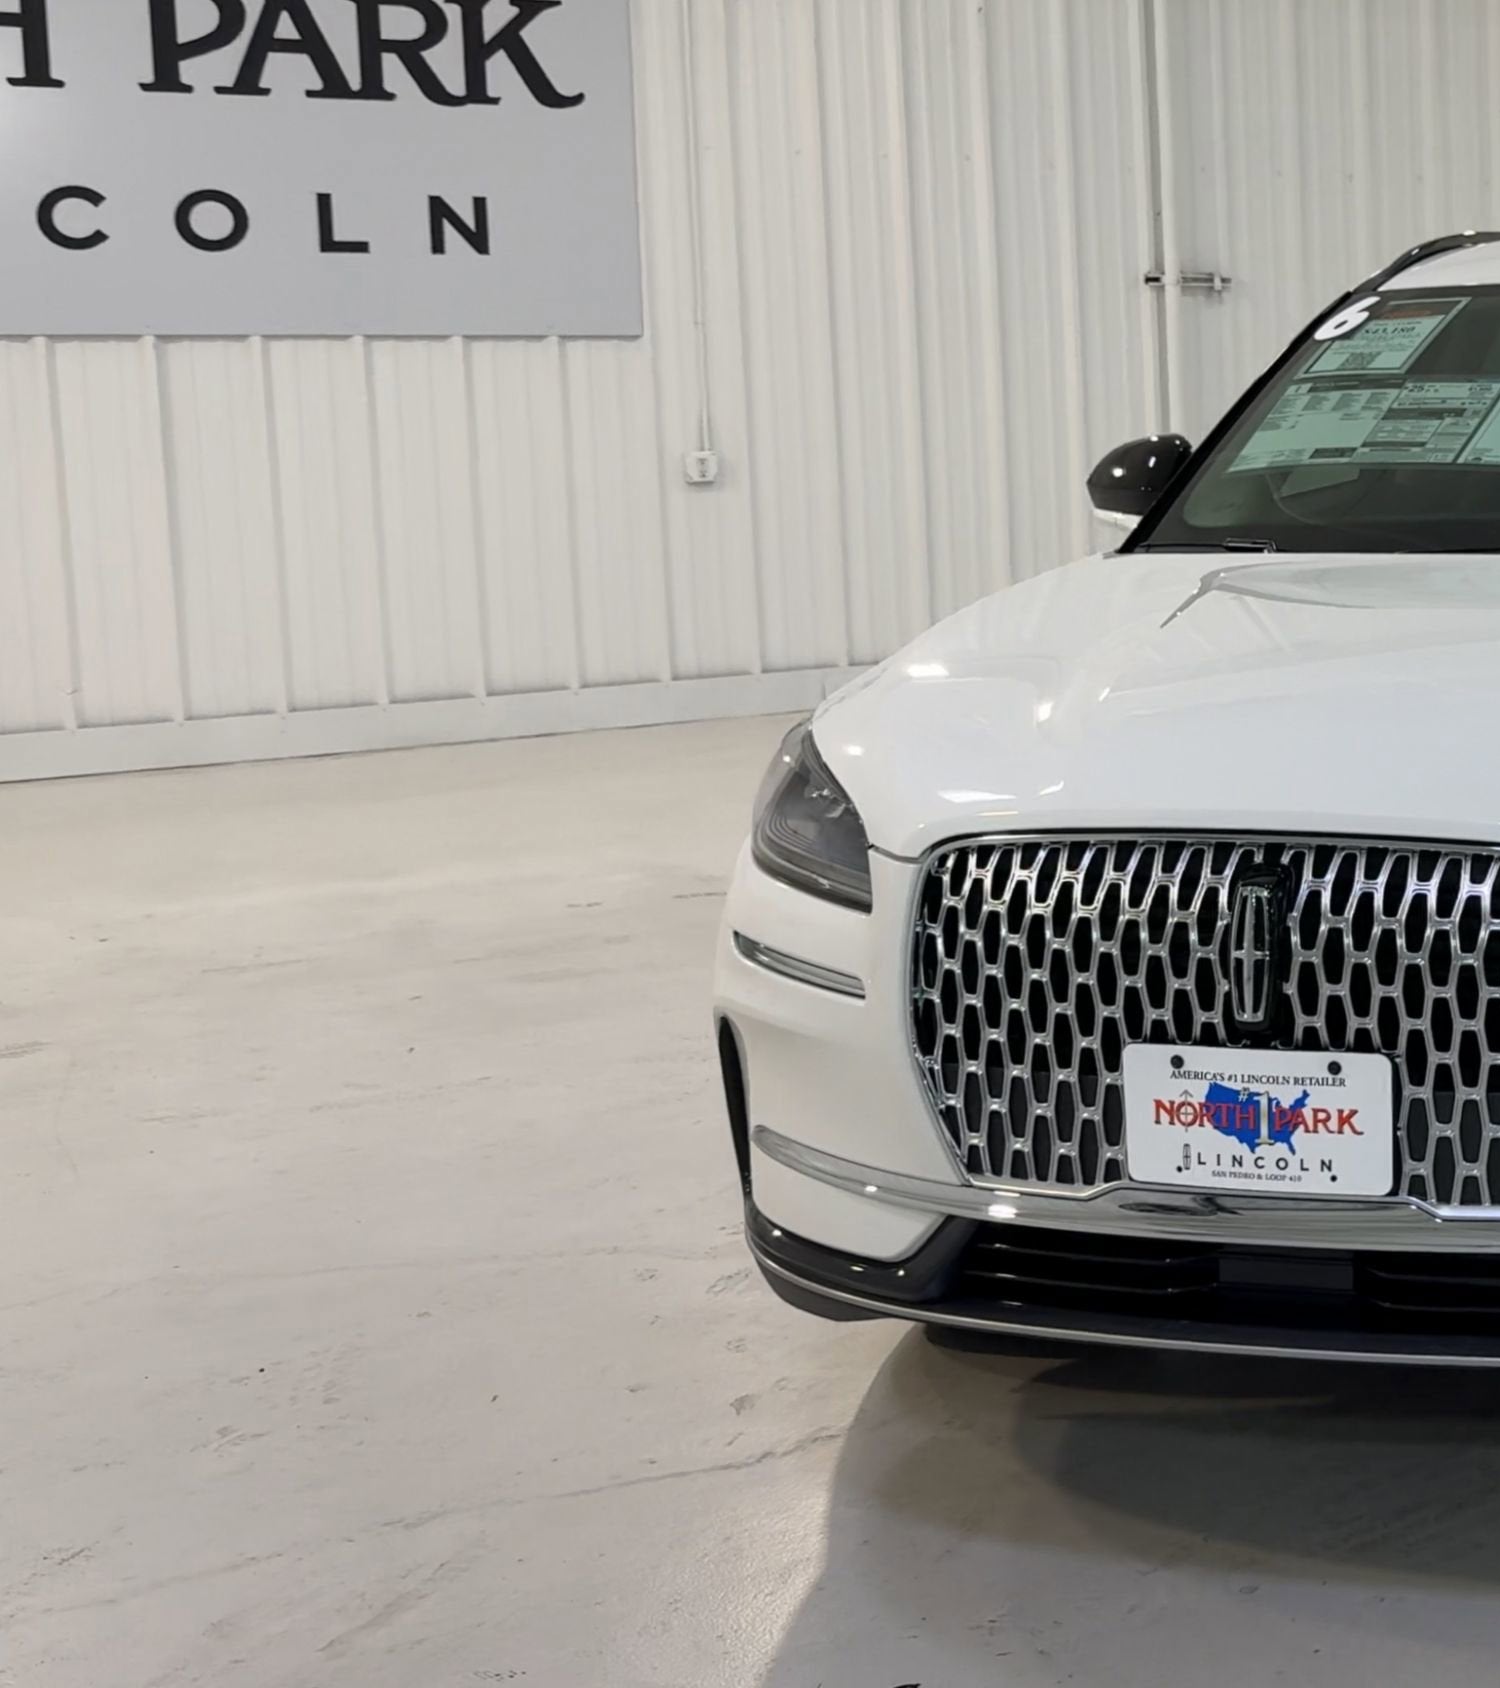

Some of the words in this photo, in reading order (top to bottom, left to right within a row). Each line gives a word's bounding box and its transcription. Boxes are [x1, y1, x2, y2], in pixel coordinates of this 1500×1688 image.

[138, 0, 586, 109] PARK
[1170, 1070, 1225, 1082] AMERICA'S
[1227, 1074, 1238, 1083] #1
[1240, 1073, 1291, 1085] LINCOLN
[1293, 1076, 1346, 1087] RETAILER
[1153, 1098, 1256, 1131] NORTH
[1273, 1105, 1364, 1135] PARK
[1197, 1152, 1333, 1172] LINCOLN
[1211, 1170, 1228, 1178] SAN
[1228, 1171, 1256, 1180] PEDRO
[1265, 1173, 1287, 1181] LOOP
